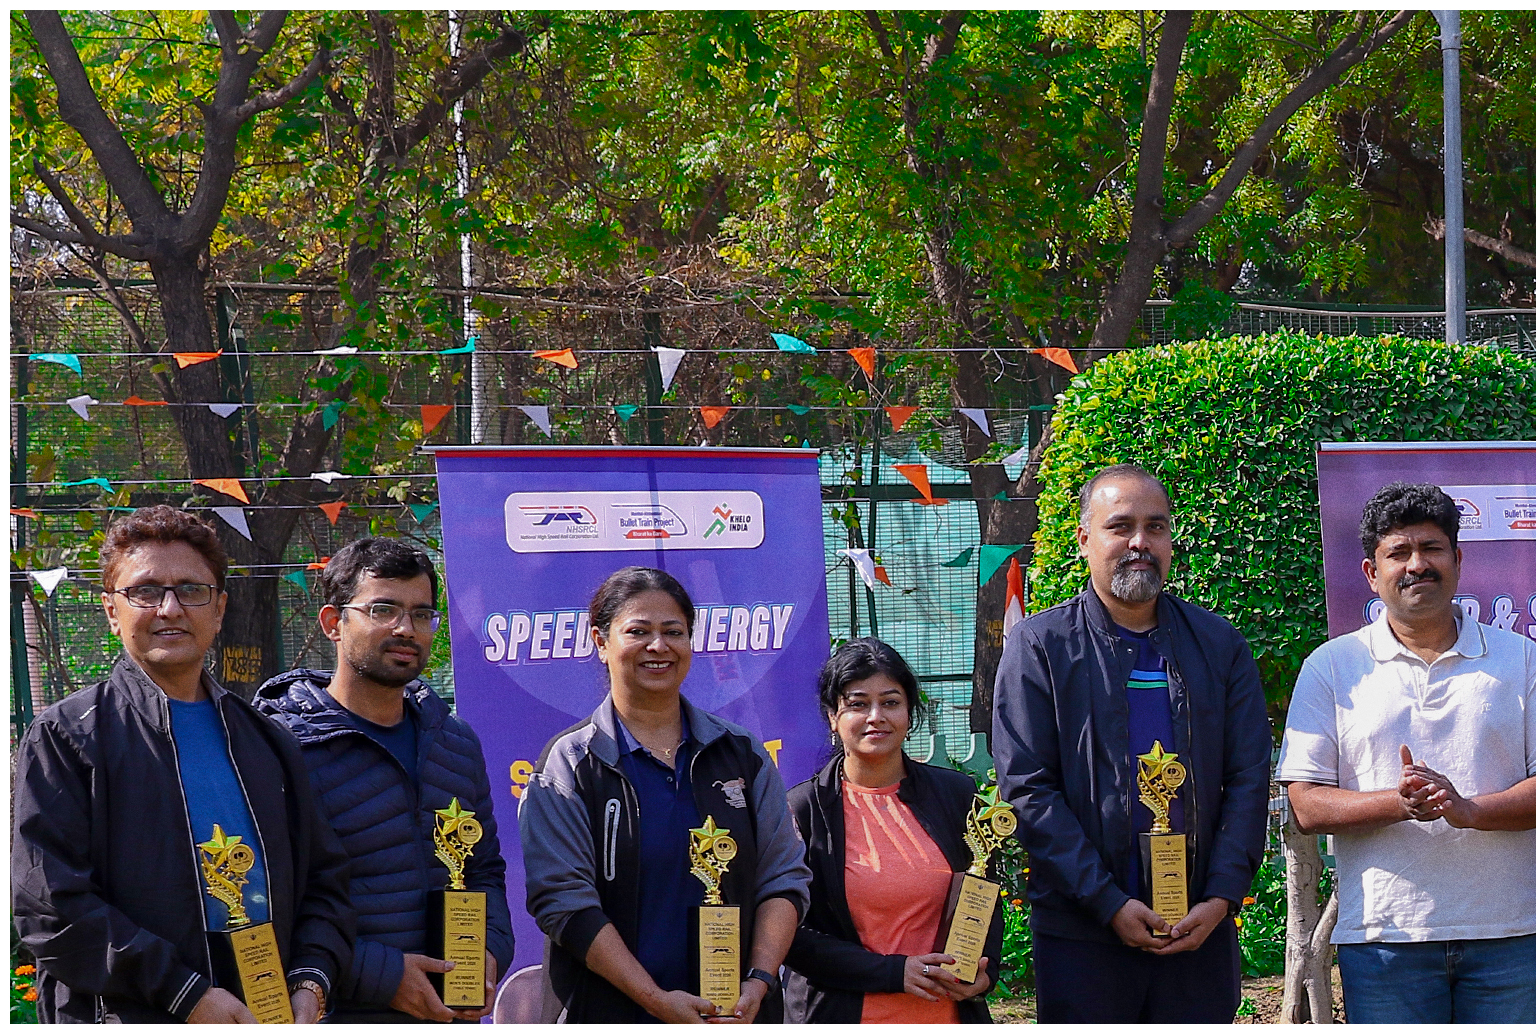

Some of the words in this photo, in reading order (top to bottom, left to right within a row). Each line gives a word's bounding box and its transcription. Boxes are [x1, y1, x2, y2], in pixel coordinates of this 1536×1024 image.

[1504, 509, 1522, 518] Bullet
[620, 518, 637, 527] Bullet
[637, 518, 653, 527] Train
[653, 517, 675, 528] Project
[729, 515, 752, 524] KHELO
[1459, 516, 1481, 525] SRCL
[565, 525, 599, 534] NHSRCL
[729, 524, 749, 532] INDIA
[1490, 596, 1520, 631] &
[485, 610, 592, 662] SPEED
[693, 604, 793, 653] NERGY
